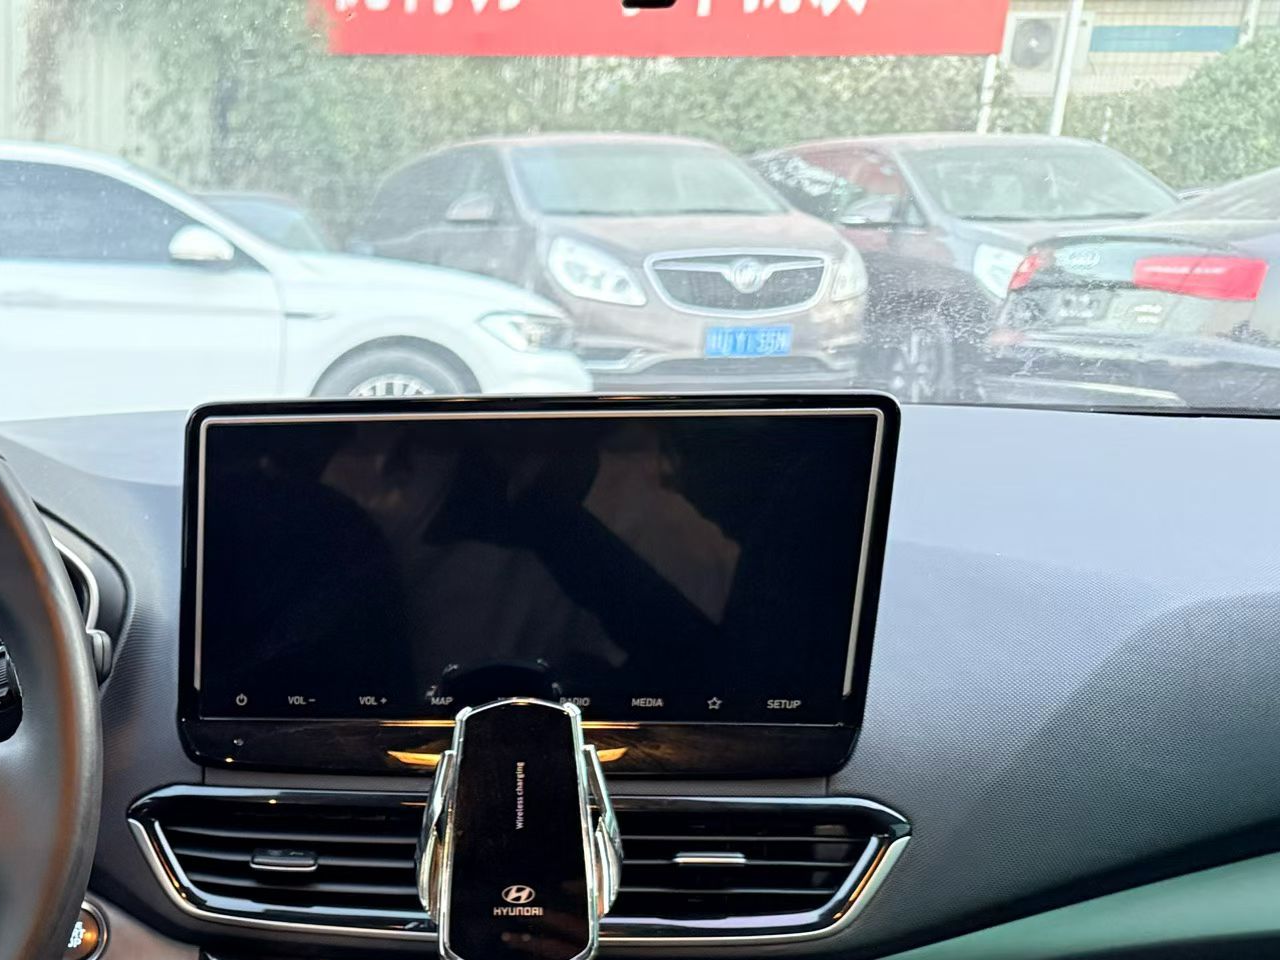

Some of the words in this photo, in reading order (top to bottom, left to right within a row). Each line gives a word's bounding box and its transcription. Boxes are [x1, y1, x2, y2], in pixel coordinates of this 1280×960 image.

[287, 695, 307, 705] VOL
[358, 695, 378, 706] VOL
[431, 696, 454, 706] MAP
[631, 697, 664, 707] MEDIA
[766, 699, 802, 709] SETUP
[515, 761, 526, 796] charging
[515, 796, 525, 830] Wireless
[493, 906, 544, 916] HYUNDAI
